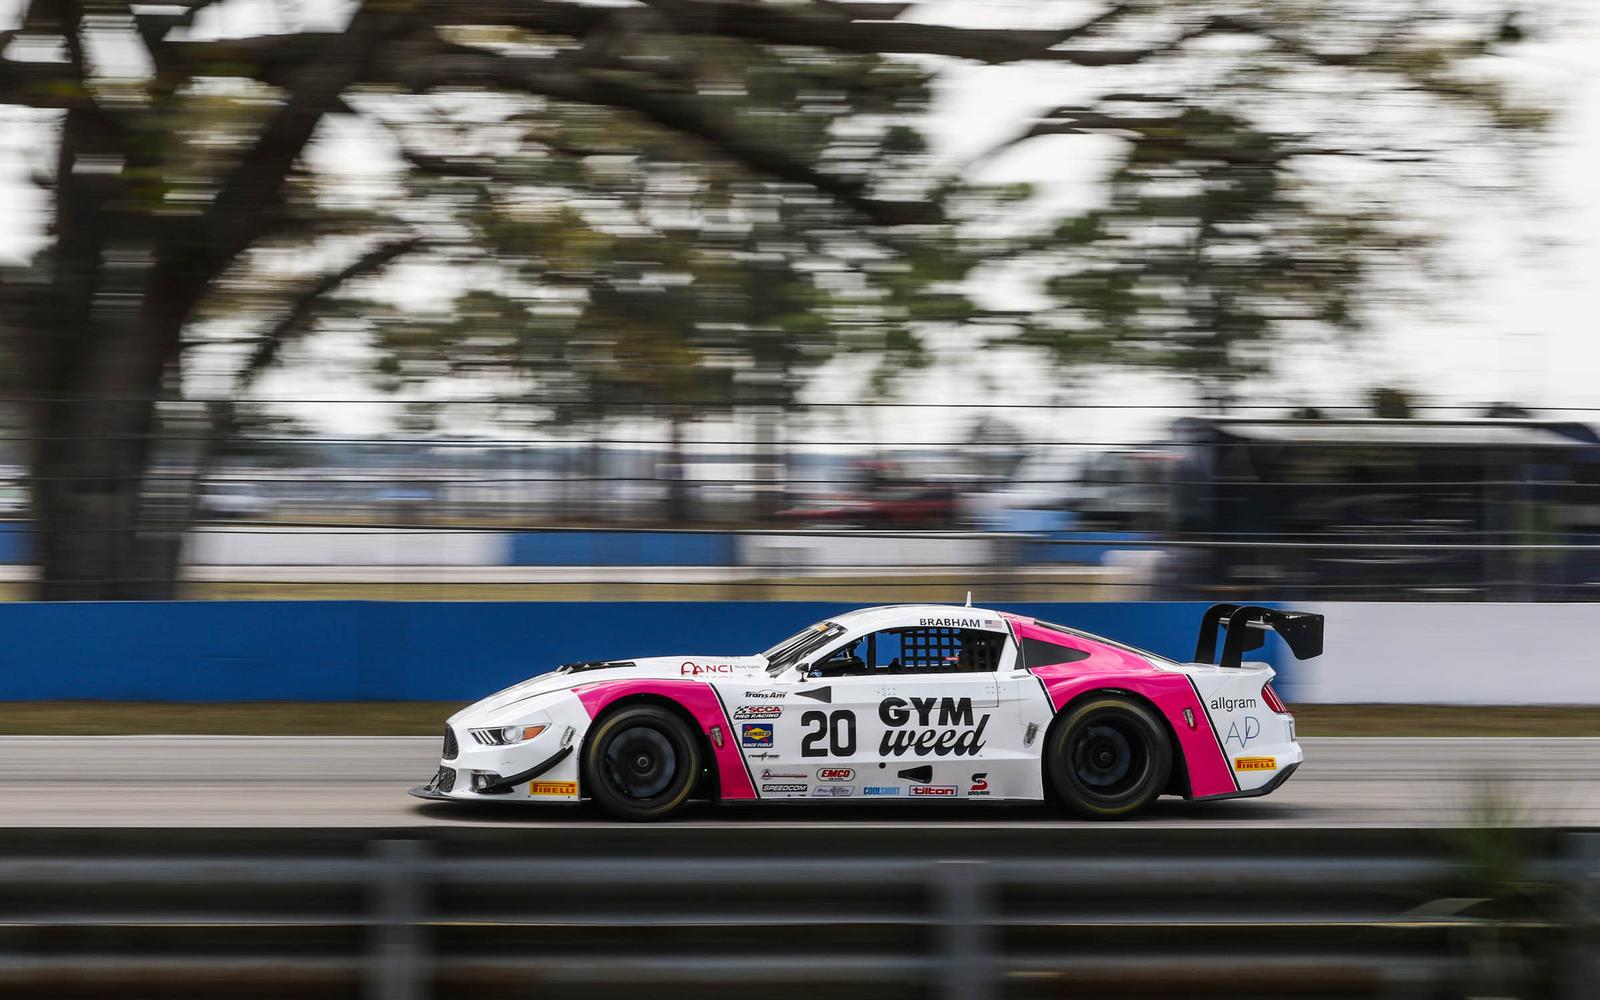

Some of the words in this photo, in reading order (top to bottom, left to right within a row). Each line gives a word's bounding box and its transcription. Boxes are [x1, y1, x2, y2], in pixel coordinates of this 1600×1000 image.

[919, 618, 980, 628] BRABHAM
[745, 691, 769, 699] Trans
[770, 691, 786, 699] Am
[1211, 697, 1257, 712] allgram
[878, 696, 974, 728] GYM
[801, 709, 857, 757] 20
[878, 714, 991, 757] weed
[1236, 759, 1275, 769] PIRELLI
[821, 769, 851, 778] EMCO
[533, 782, 576, 793] PIRELLI
[912, 786, 954, 795] tilton
